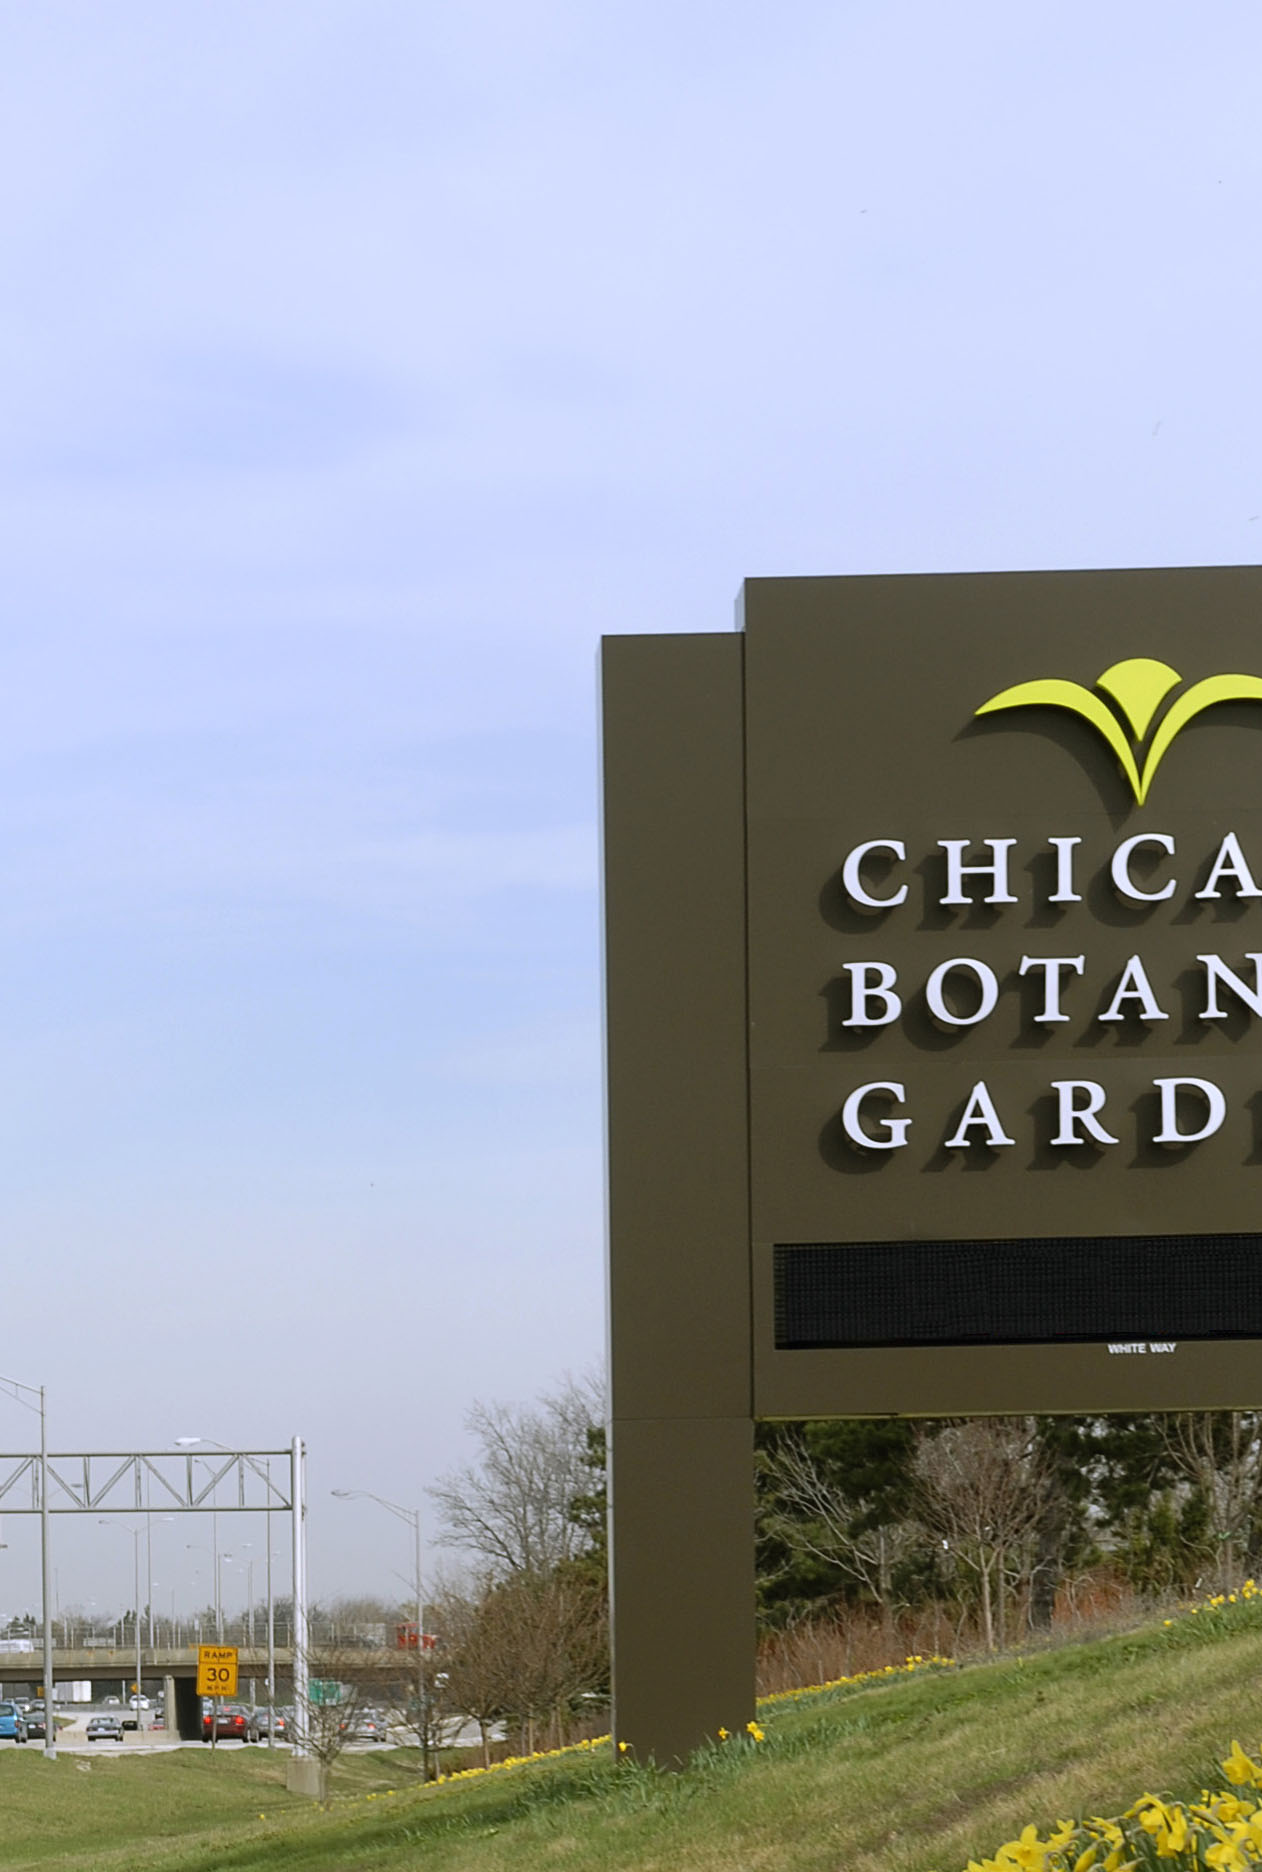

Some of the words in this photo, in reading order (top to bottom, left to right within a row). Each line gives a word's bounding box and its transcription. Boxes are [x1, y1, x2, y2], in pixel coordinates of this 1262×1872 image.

[1107, 1343, 1147, 1354] WHITE
[1149, 1342, 1177, 1353] WAY
[203, 1651, 233, 1659] RAMP
[206, 1667, 230, 1682] 30
